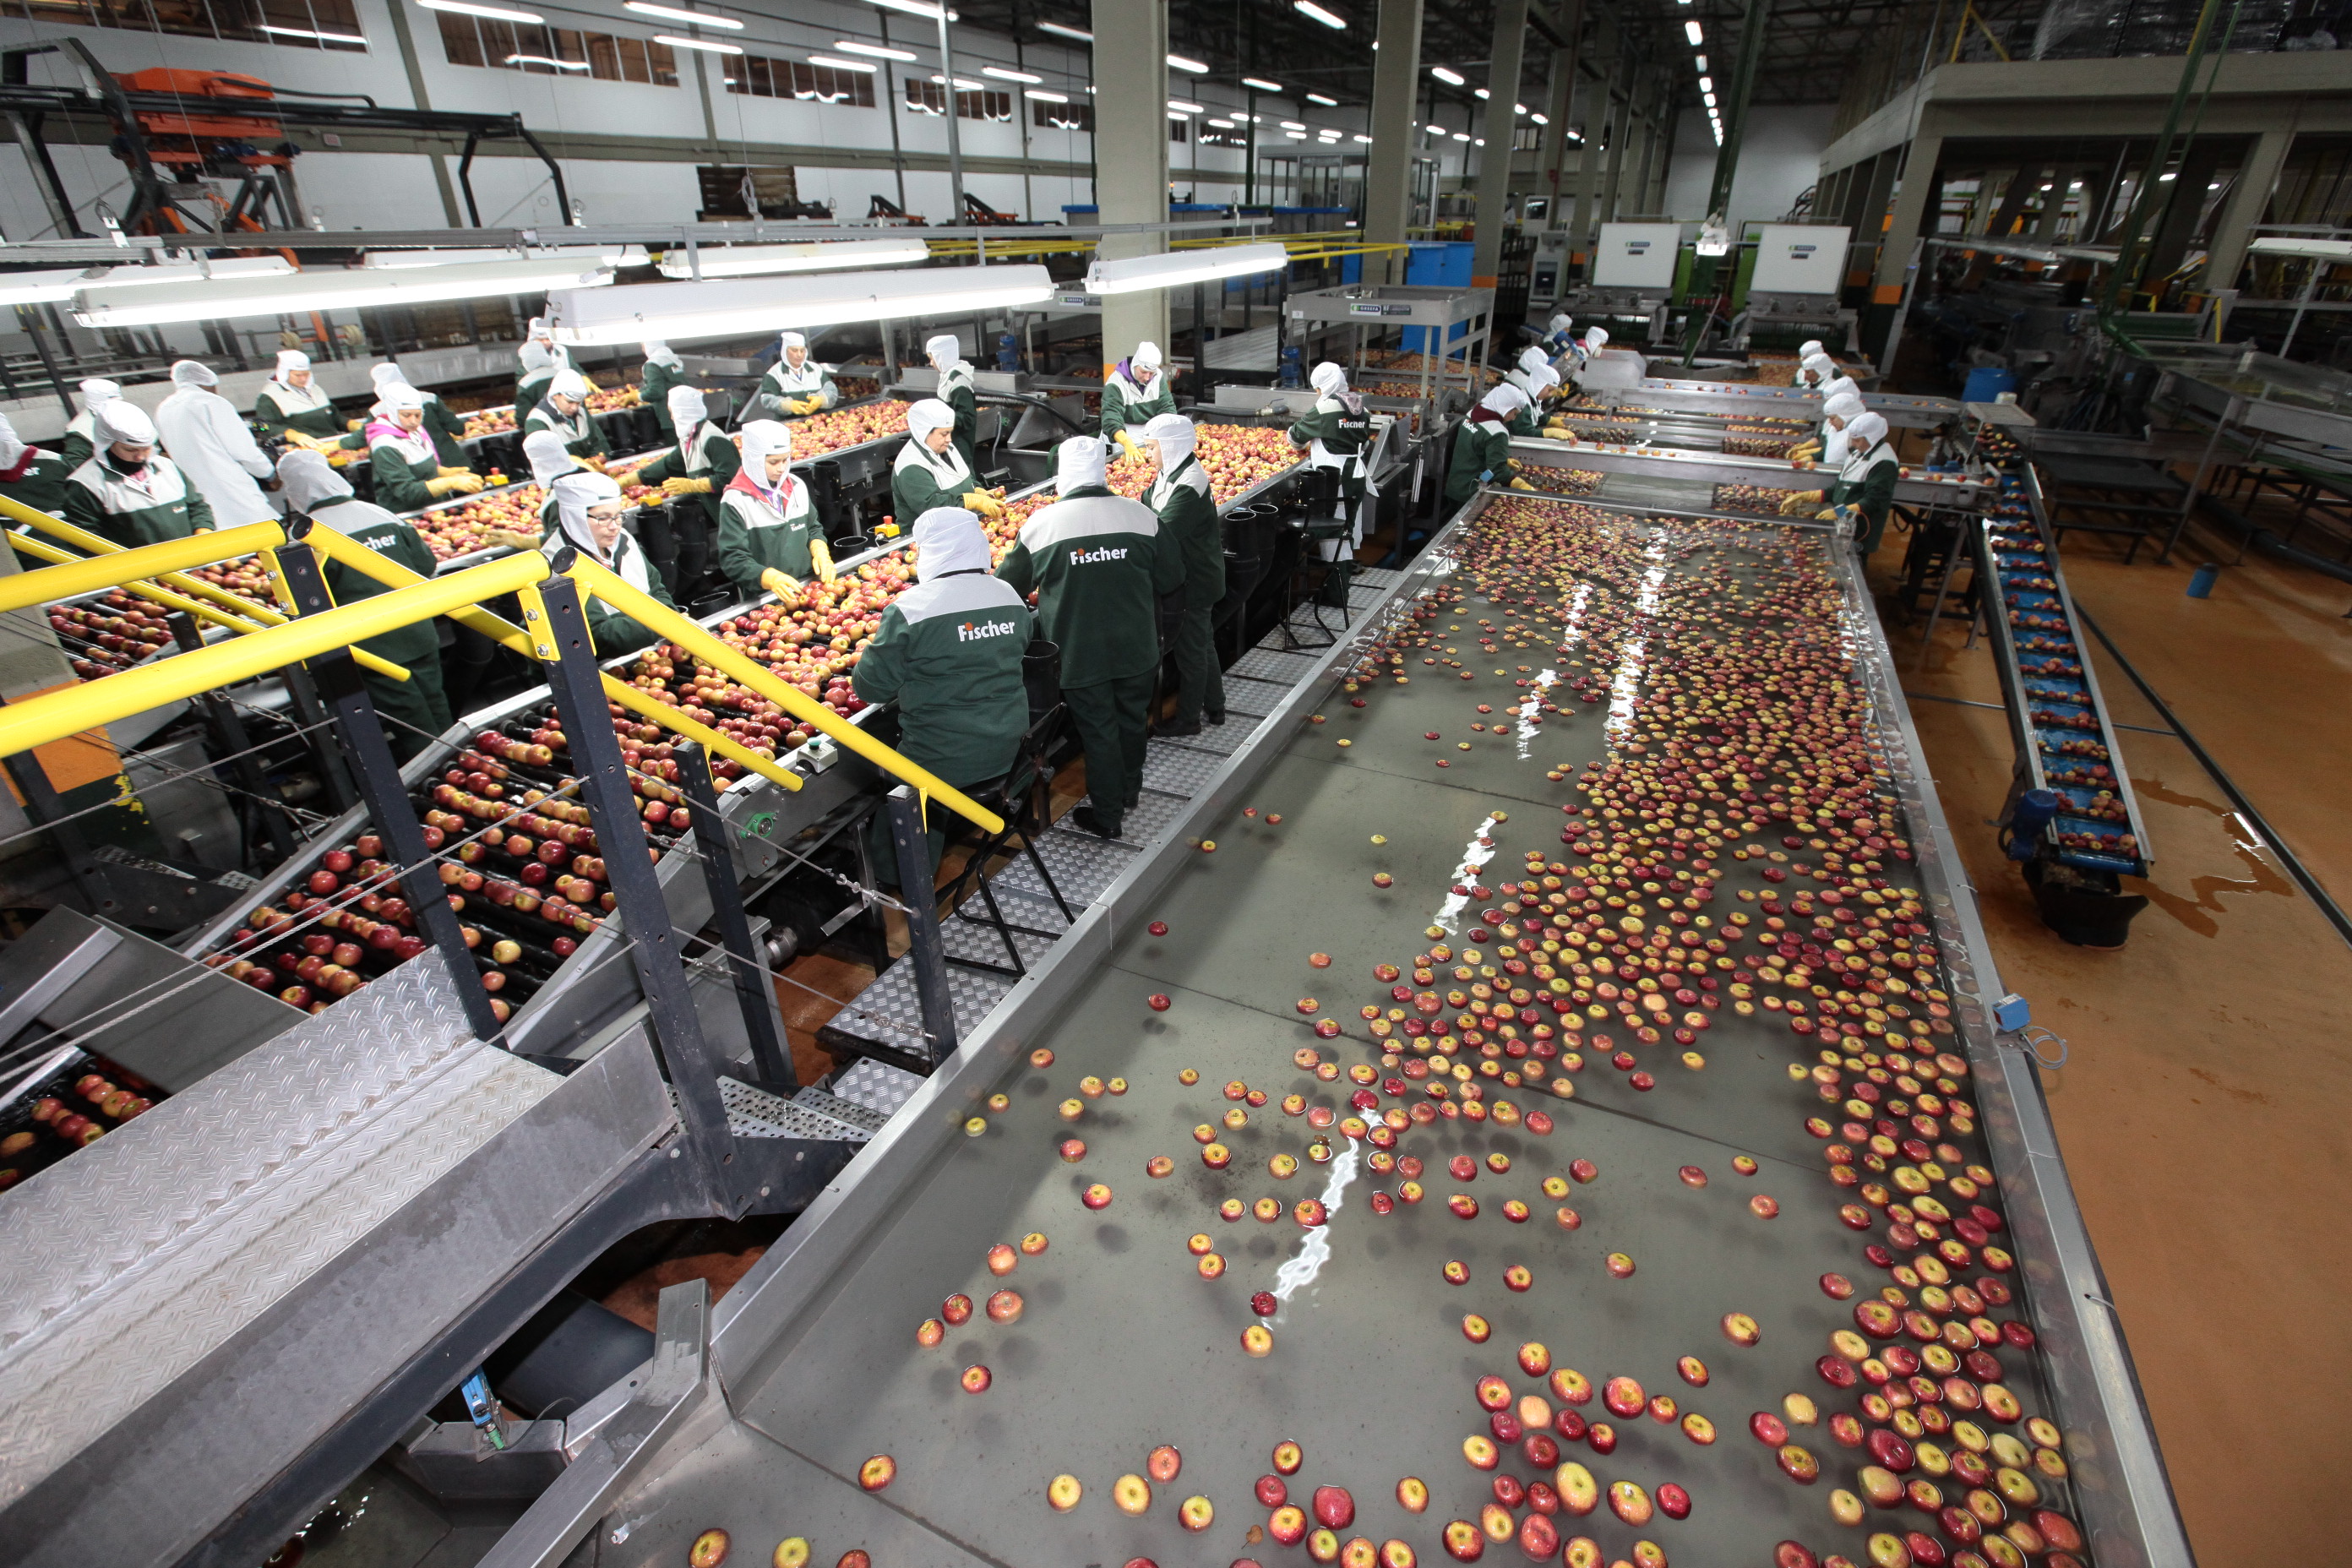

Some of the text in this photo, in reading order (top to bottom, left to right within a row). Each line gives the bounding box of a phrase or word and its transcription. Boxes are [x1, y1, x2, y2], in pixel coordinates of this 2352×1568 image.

[1338, 417, 1365, 428] Fischer
[362, 534, 396, 550] cher
[1070, 546, 1128, 565] Fischer
[957, 619, 1015, 642] Fischer
